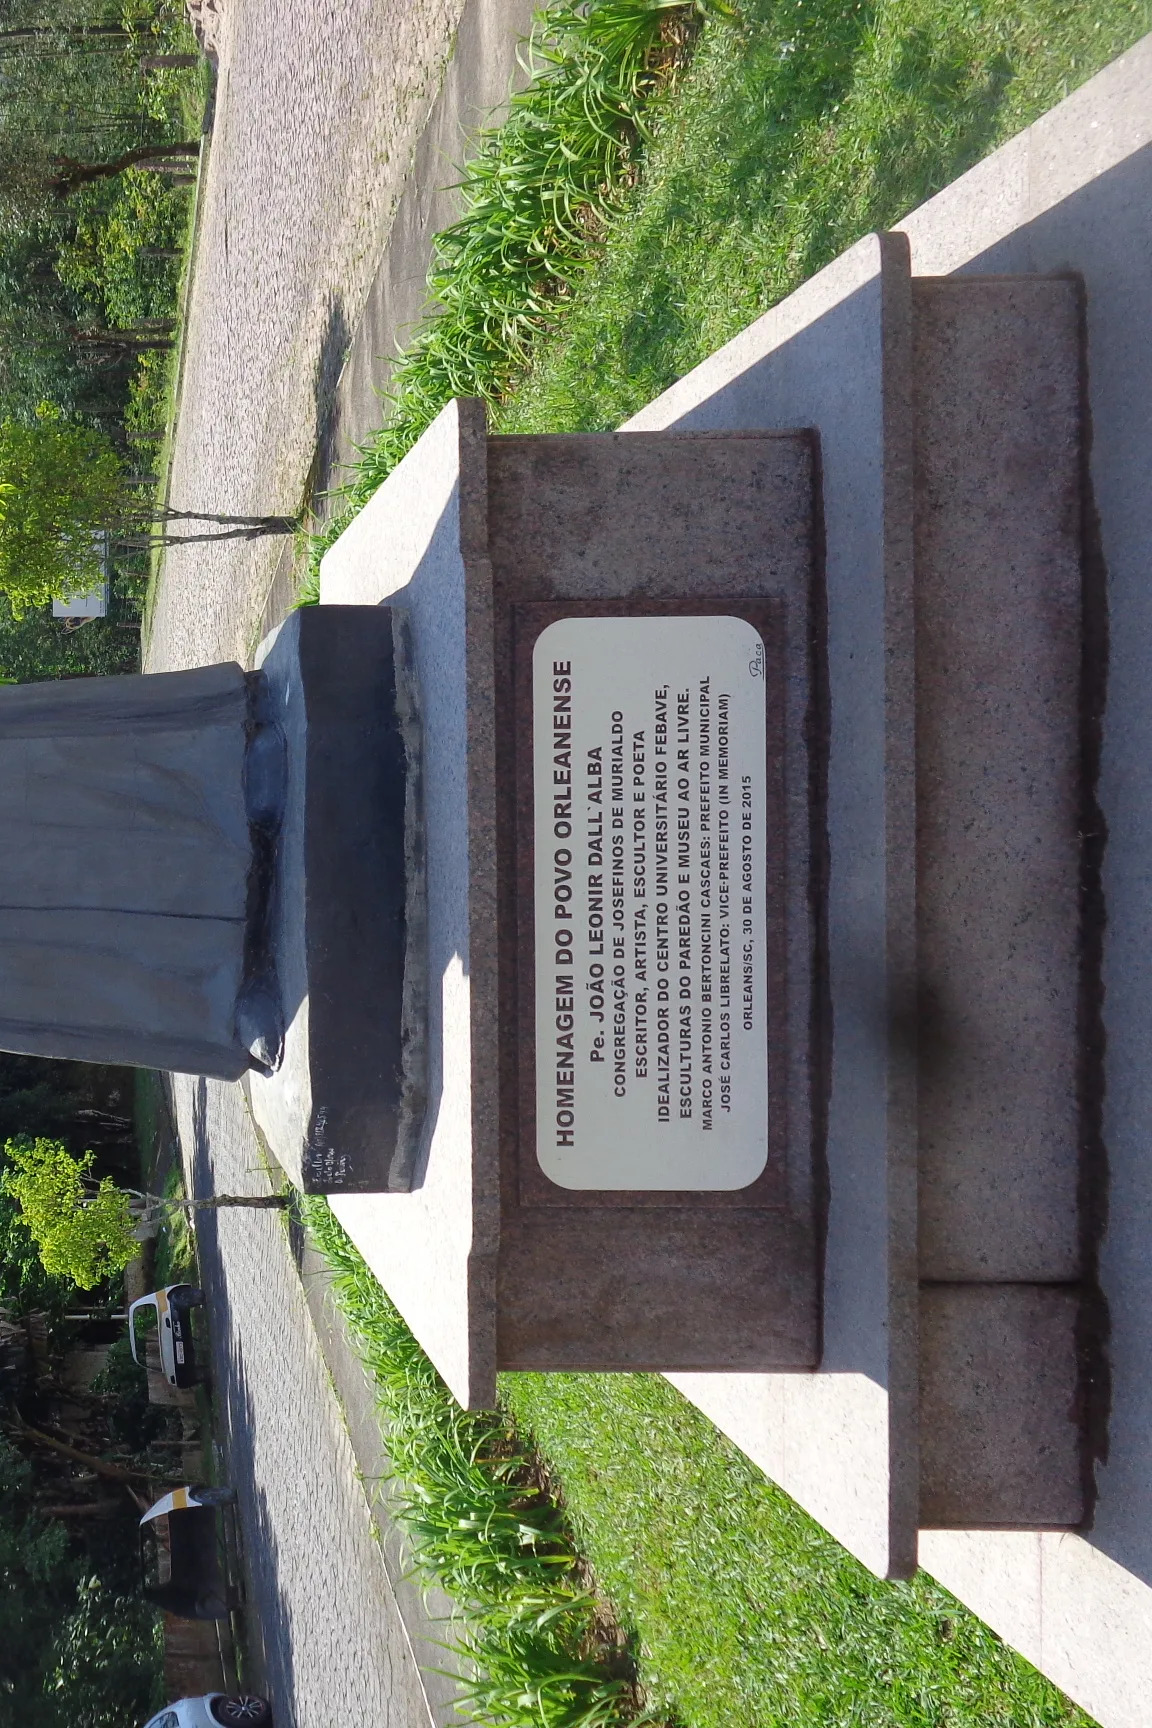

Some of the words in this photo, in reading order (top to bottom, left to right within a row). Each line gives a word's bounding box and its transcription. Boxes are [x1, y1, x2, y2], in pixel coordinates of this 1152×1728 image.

[655, 684, 670, 755] FEBAVE,
[677, 688, 690, 743] LIVRE.
[699, 676, 710, 757] MUNICIPAL
[718, 694, 731, 780] MEMORIAM)
[553, 661, 572, 839] ORLEANENSE
[611, 711, 624, 801] MURIALDO
[632, 730, 646, 786] POETA
[677, 748, 689, 773] AR
[611, 807, 624, 829] DE
[633, 792, 645, 802] E
[677, 778, 690, 802] AO
[699, 761, 711, 832] PREFEITO
[718, 785, 732, 805] (IN
[741, 776, 752, 808] 2015
[742, 812, 752, 830] DE
[633, 808, 646, 898] ESCULTOR
[652, 761, 668, 896] UNIVERSITÁRIO
[677, 807, 690, 868] MUSEU
[554, 848, 573, 919] POVO
[611, 835, 625, 932] JOSEFINOS
[678, 873, 690, 884] E
[700, 836, 711, 908] CASCAES:
[718, 810, 729, 919] VICE-PREFEITO
[742, 835, 752, 892] AGOSTO
[588, 873, 604, 955] LEONIR
[656, 902, 669, 972] CENTRO
[675, 890, 691, 970] PAREDÃO
[742, 896, 752, 914] DE
[742, 919, 753, 935] 30
[555, 929, 573, 965] DO
[613, 937, 625, 959] DE
[634, 904, 649, 982] ARTISTA,
[700, 913, 712, 1003] BERTONCINI
[719, 924, 730, 1008] LIBRELATO:
[585, 963, 605, 1023] JOÃO
[657, 978, 669, 1002] DO
[679, 976, 691, 999] DO
[743, 939, 755, 1031] ORLEANS/SC,
[555, 975, 574, 1147] HOMENAGEM
[590, 1031, 605, 1062] Pe.
[611, 965, 629, 1097] CONGREGAÇÃO
[635, 987, 650, 1078] ESCRITOR,
[657, 1007, 670, 1122] IDEALIZADOR
[679, 1005, 692, 1118] ESCULTURAS
[701, 1007, 712, 1074] ANTONIO
[720, 1012, 730, 1071] CARLOS
[702, 1079, 713, 1130] MARCO
[718, 1075, 731, 1113] JOSÉ
